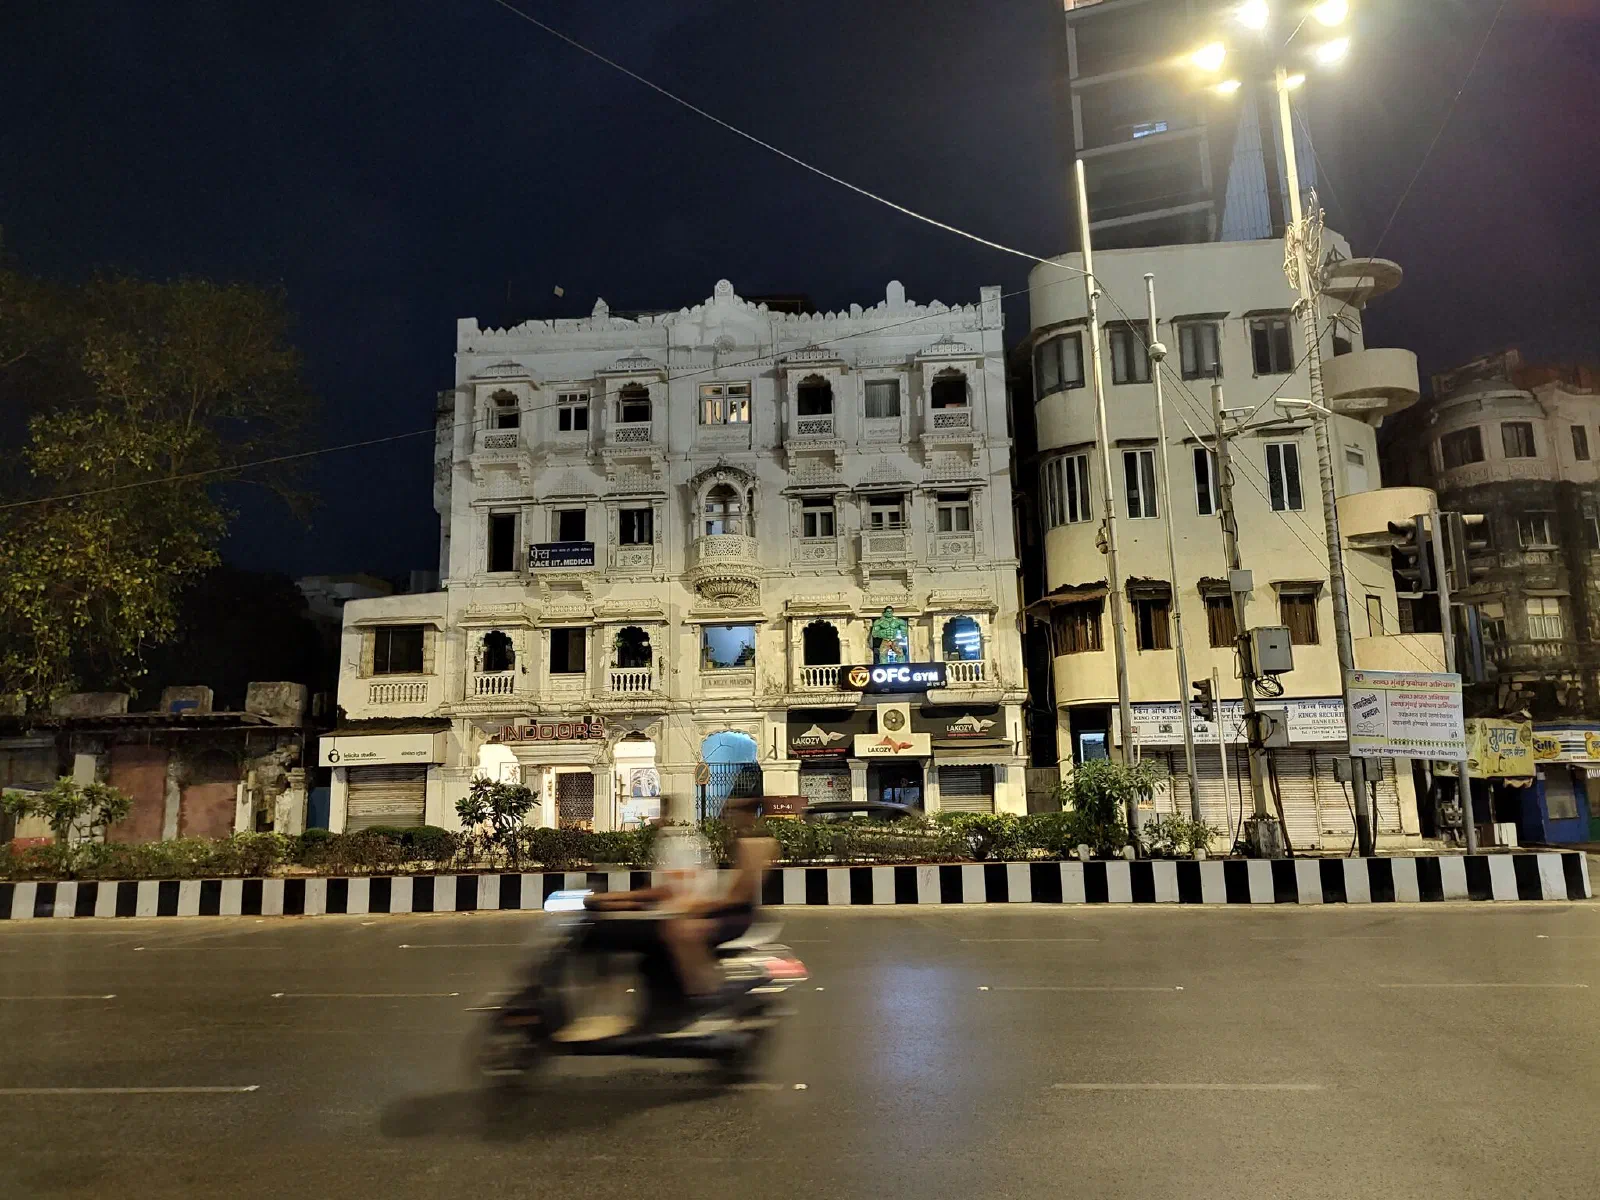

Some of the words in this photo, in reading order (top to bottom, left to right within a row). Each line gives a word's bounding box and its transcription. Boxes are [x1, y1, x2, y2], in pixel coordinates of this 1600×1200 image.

[872, 667, 910, 682] OFC
[913, 672, 938, 681] GYM
[500, 723, 604, 740] INDOORS
[1488, 727, 1518, 752] सुमन
